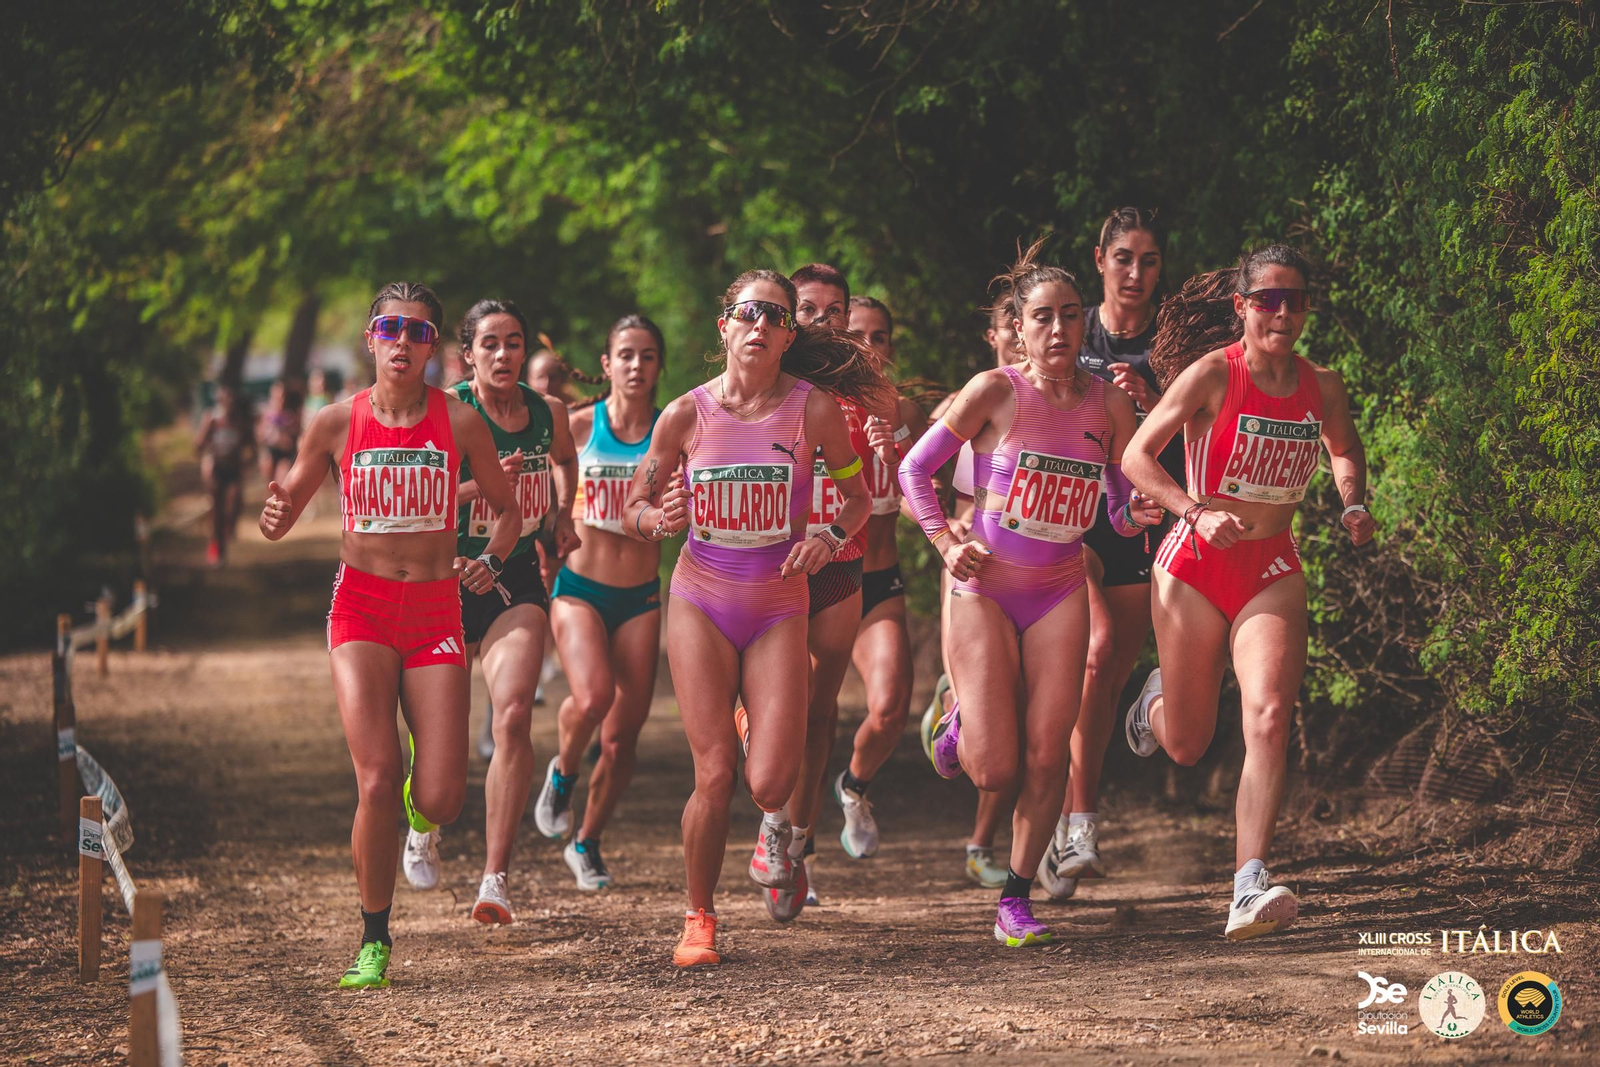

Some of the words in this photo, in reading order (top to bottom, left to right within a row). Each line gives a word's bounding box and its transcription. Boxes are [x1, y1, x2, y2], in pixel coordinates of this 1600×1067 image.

[1266, 423, 1307, 437] ITÁLICA
[377, 450, 422, 463] ITÁLICA
[1044, 459, 1085, 475] ITÁLICA
[1224, 432, 1321, 489] BARREIRO
[352, 466, 445, 518] MACHADO
[694, 482, 787, 532] GALLARDO
[1005, 469, 1099, 529] FORERO
